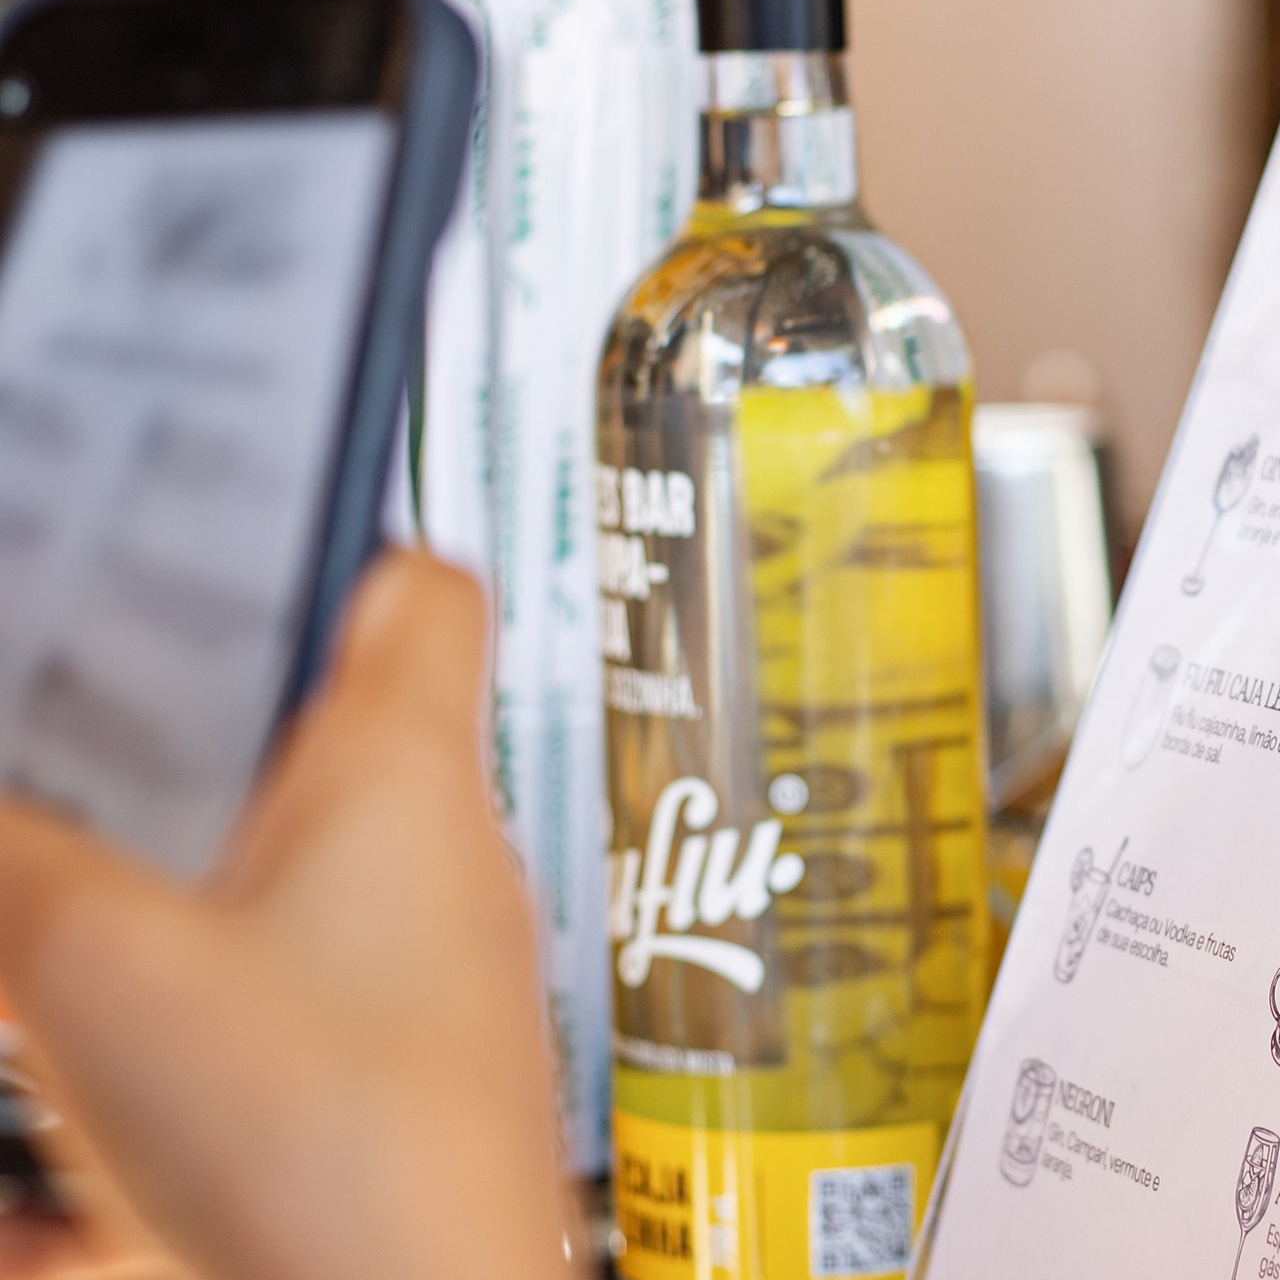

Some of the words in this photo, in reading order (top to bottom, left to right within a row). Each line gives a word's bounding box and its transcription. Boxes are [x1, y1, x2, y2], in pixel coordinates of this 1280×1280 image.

[623, 466, 697, 538] BAR
[1271, 531, 1280, 546] e
[1181, 662, 1207, 691] FIU
[1204, 668, 1231, 697] FIU
[1228, 674, 1266, 706] CAJA
[1190, 740, 1205, 759] de
[1204, 744, 1223, 764] sal.
[1198, 713, 1246, 745] cajazinha,
[1247, 724, 1279, 752] limão
[1116, 861, 1157, 896] CAIPS
[1097, 926, 1112, 943] de
[1110, 932, 1130, 951] sua
[1129, 940, 1169, 968] escolha.
[1106, 898, 1150, 933] Cachaça
[1149, 917, 1164, 935] ou
[1163, 918, 1197, 947] Vodka
[1195, 933, 1206, 950] e
[1203, 932, 1237, 962] frutas
[1059, 1078, 1115, 1128] NEGRONI
[1066, 1130, 1109, 1170] Campari,
[1109, 1154, 1153, 1188] vermute
[1151, 1174, 1161, 1192] e
[1258, 1255, 1280, 1279] gás
